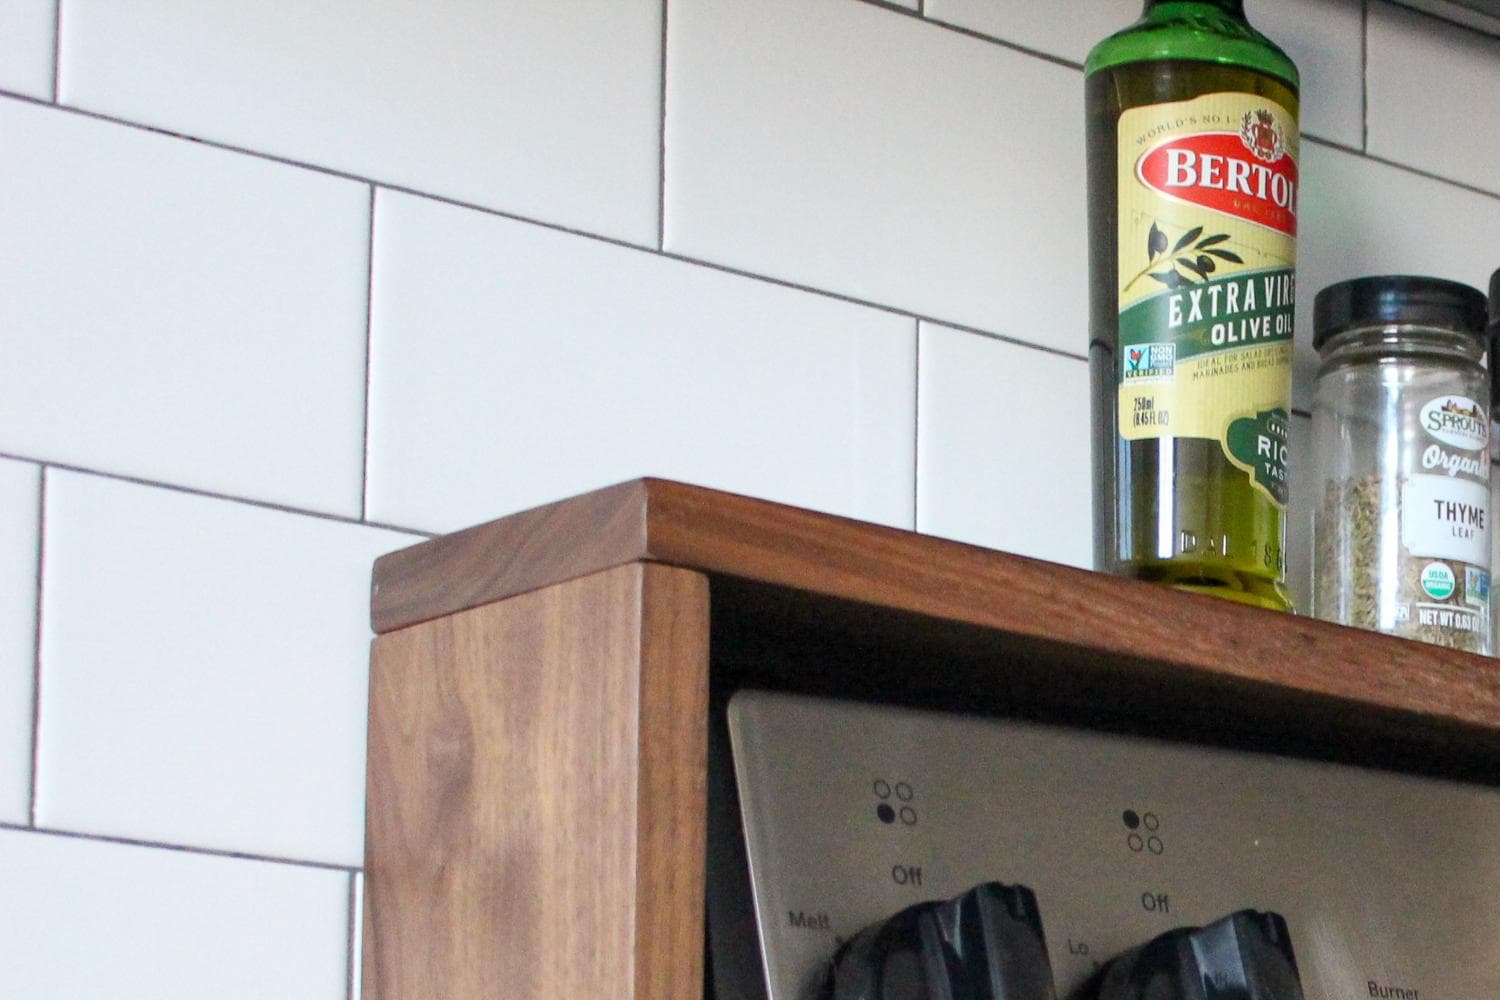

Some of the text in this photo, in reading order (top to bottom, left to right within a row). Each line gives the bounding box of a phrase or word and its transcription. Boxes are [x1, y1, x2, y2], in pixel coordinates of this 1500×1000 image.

[1136, 115, 1197, 146] WORLD'S
[1168, 279, 1257, 328] EXTRA
[1211, 314, 1292, 346] OLIVE OIL
[1434, 499, 1484, 529] THYME
[1452, 526, 1475, 540] LEAF
[1420, 609, 1438, 626] NET
[1440, 611, 1454, 628] WT
[892, 864, 923, 886] Off
[1141, 891, 1169, 913] Off
[788, 910, 830, 930] Melt
[1068, 938, 1090, 955] Lo
